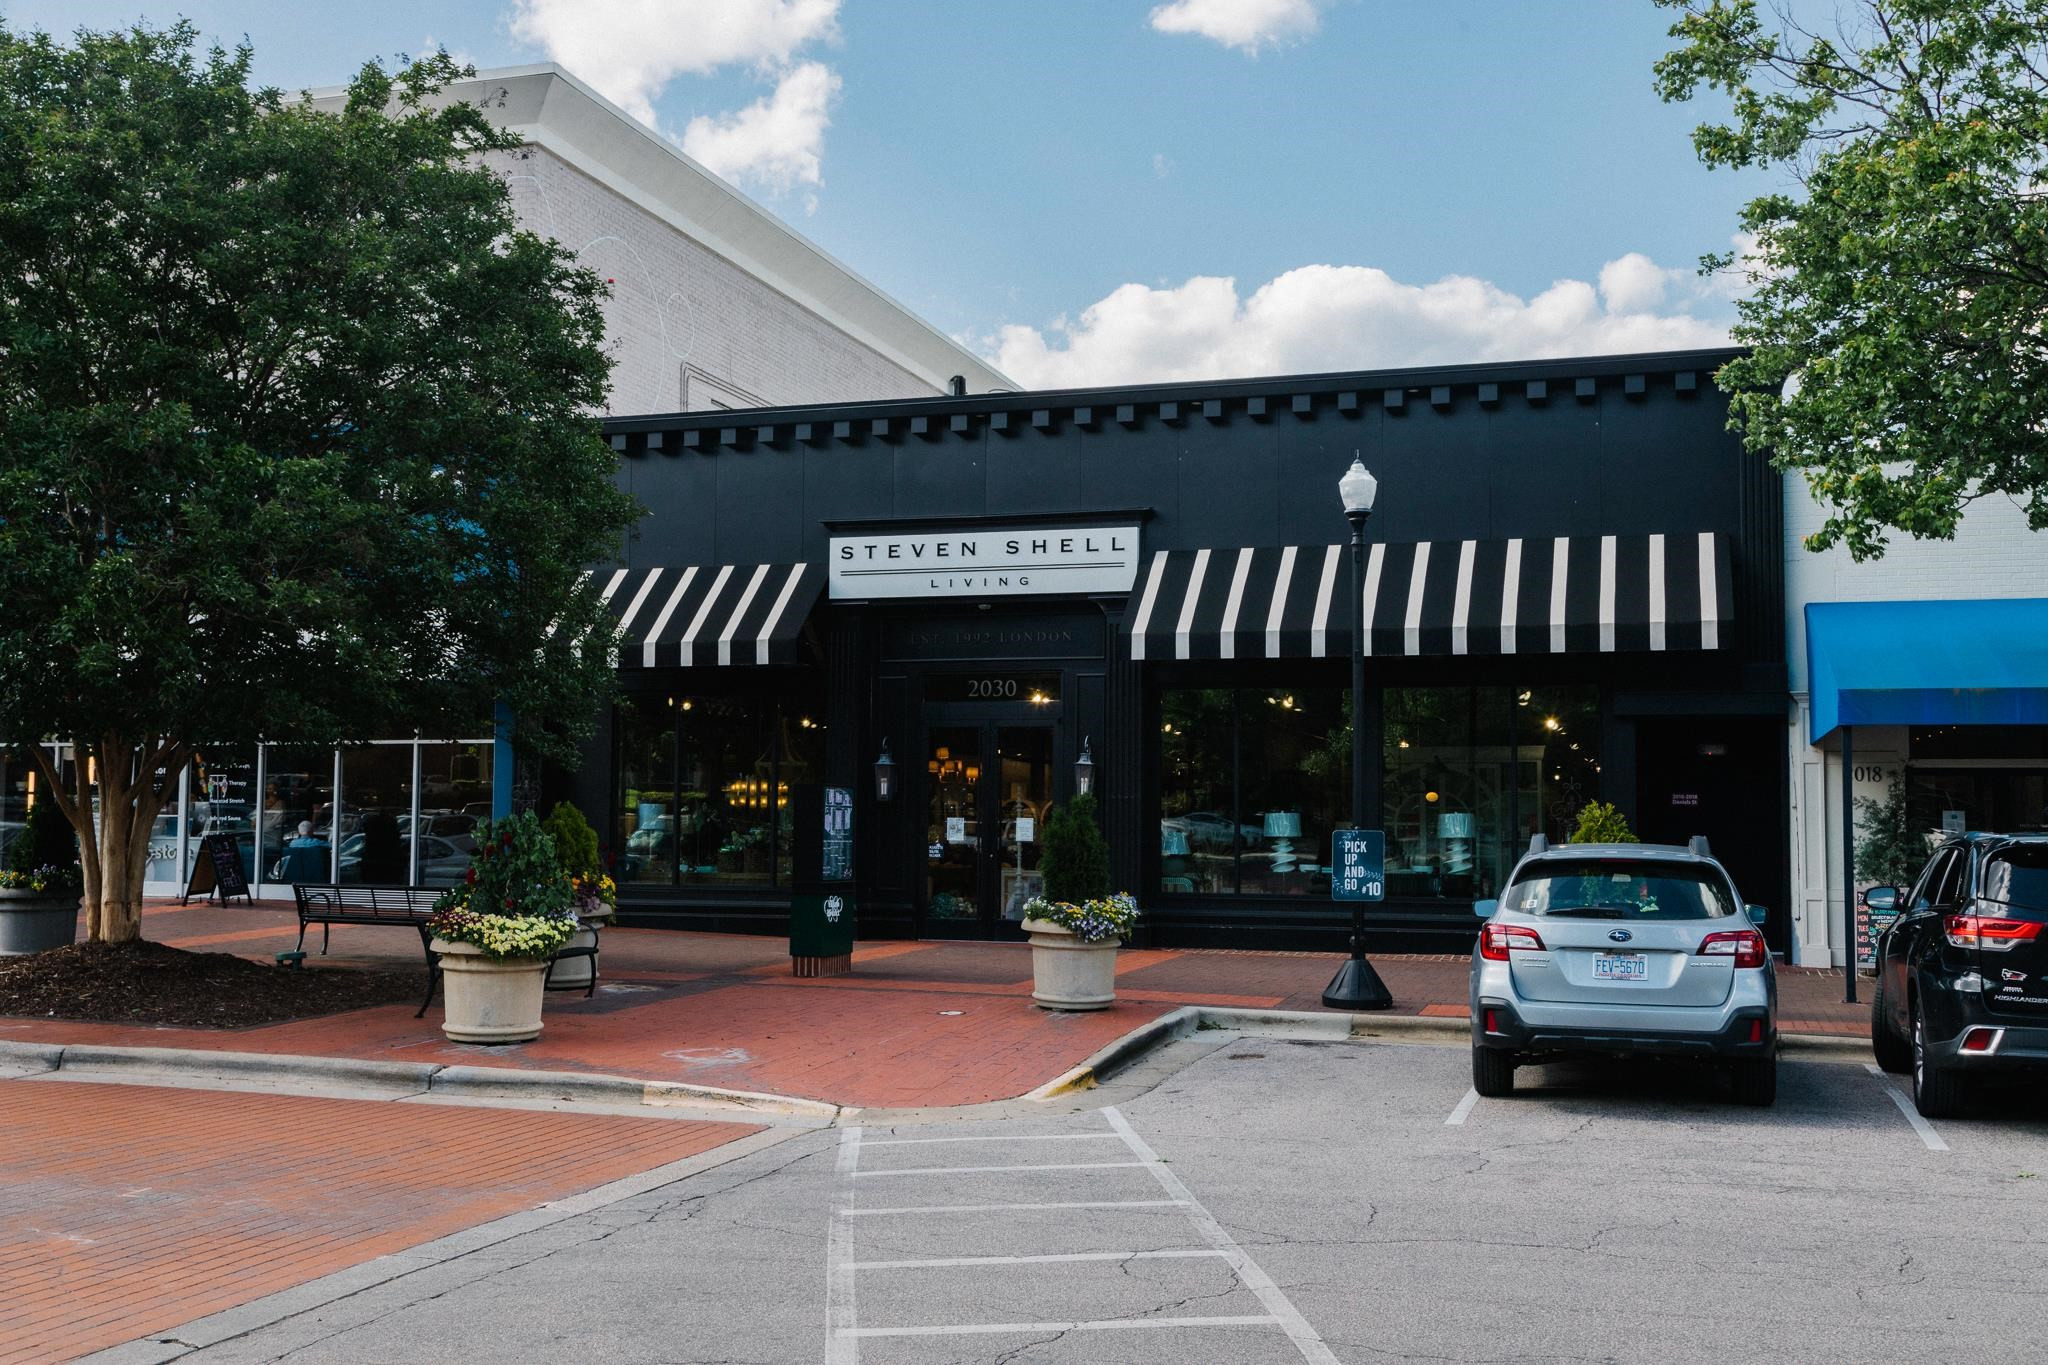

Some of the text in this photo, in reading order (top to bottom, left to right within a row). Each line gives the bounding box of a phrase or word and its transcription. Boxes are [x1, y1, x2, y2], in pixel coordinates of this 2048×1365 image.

[840, 536, 1126, 560] STEVEN SHELL
[930, 576, 1031, 588] LIVING
[955, 632, 991, 644] 1992
[1000, 631, 1074, 643] LONDON
[968, 679, 1017, 697] 2030
[1344, 840, 1367, 853] PICK
[1344, 853, 1358, 865] UP
[1344, 866, 1364, 878] AND
[1344, 878, 1358, 891] GO
[1361, 881, 1382, 896] #10
[1857, 914, 1869, 922] MON
[1857, 935, 1869, 943] WED
[1596, 959, 1645, 974] FEV-5670
